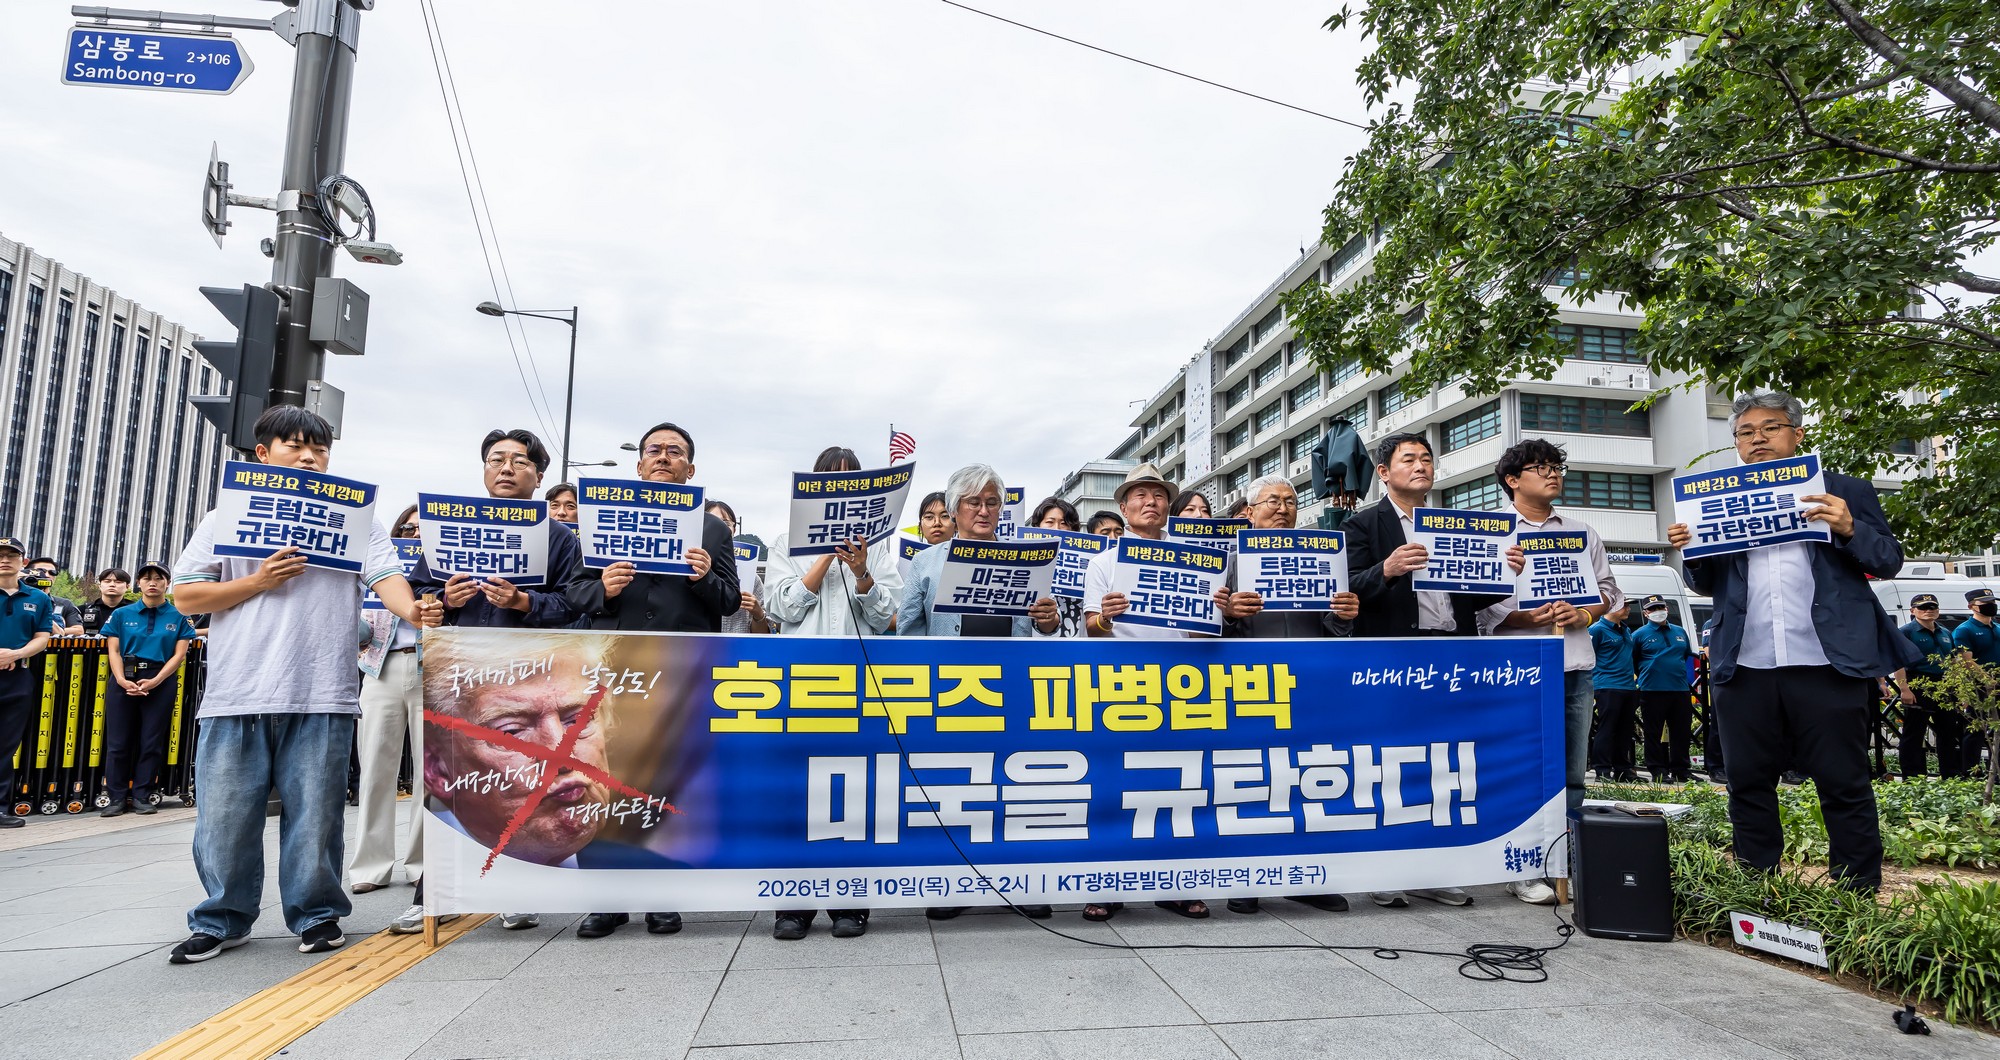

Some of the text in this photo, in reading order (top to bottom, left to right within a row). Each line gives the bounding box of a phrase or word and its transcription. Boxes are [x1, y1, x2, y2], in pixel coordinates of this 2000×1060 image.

[78, 35, 164, 61] 삼봉로
[73, 63, 196, 85] Sambong-ro
[234, 471, 366, 504] 파병강요 국제깡패
[798, 472, 909, 492] 이란 침략전쟁 파병강요
[1683, 464, 1808, 495] 파병강요 국제깡패
[586, 486, 694, 507] 파병강요 국제깡패
[824, 497, 887, 521] 미국을
[1701, 491, 1796, 521] 트럼프를
[247, 495, 345, 529] 트럼프를
[427, 502, 537, 522] 파병강요 국제깡패
[597, 509, 678, 535] 트럼프를
[1422, 515, 1510, 532] 파병강요 국제깡패
[236, 520, 348, 555] 규탄한다!
[440, 525, 522, 550] 트럼프를
[808, 514, 892, 544] 규탄한다!
[1175, 523, 1213, 535] 파병강요
[1697, 511, 1807, 543] 규탄한다!
[593, 533, 683, 560] 규탄한다!
[953, 546, 1055, 561] 이란 침략전쟁 파병강요
[1064, 536, 1101, 551] 국제깡패
[1246, 536, 1294, 548] 파병강요
[1297, 537, 1339, 550] 국제깡패
[1434, 537, 1498, 558] 트럼프를
[1520, 537, 1583, 550] 파병강요 국제깡패
[435, 548, 528, 574] 규탄한다!
[1127, 546, 1176, 563] 파병강요
[1180, 551, 1223, 570] 국제깡패
[1260, 556, 1331, 576] 트럼프를
[1428, 559, 1502, 581] 규탄한다!
[1533, 557, 1578, 576] 트럼프를
[1607, 554, 1632, 562] POLICE
[970, 567, 1031, 588] 미국을
[1137, 568, 1211, 595] 트럼프를
[1255, 578, 1337, 598] 규탄한다!
[1531, 576, 1587, 598] 규탄한다!
[952, 586, 1038, 607] 규탄한다!
[1129, 591, 1214, 620] 규탄한다!
[446, 653, 555, 697] 국제깡패!
[581, 662, 661, 699] 날강도!
[1352, 660, 1541, 692] 미대사관 앞 기자회견
[69, 675, 78, 718] POLICE
[709, 660, 1297, 734] 호르무즈 파병압박
[38, 674, 54, 756] 질서유지선
[90, 674, 107, 756] 질서유지선
[444, 760, 547, 794] 내정간섭!
[806, 741, 1478, 844] 미국을 규탄한다!
[566, 795, 666, 828] 경제수탈!
[1504, 841, 1543, 873] 촛불행동
[758, 879, 830, 898] 2026년
[836, 877, 869, 897] 9월
[873, 876, 950, 897] 10일(목)
[956, 875, 995, 895] 오후
[998, 874, 1030, 894] 2시
[1058, 867, 1250, 892] KT광화문빌딩(광화문역
[1256, 867, 1283, 886] 2번
[1288, 865, 1327, 885] 출구)
[1758, 930, 1819, 953] 정원을 아껴주세요
